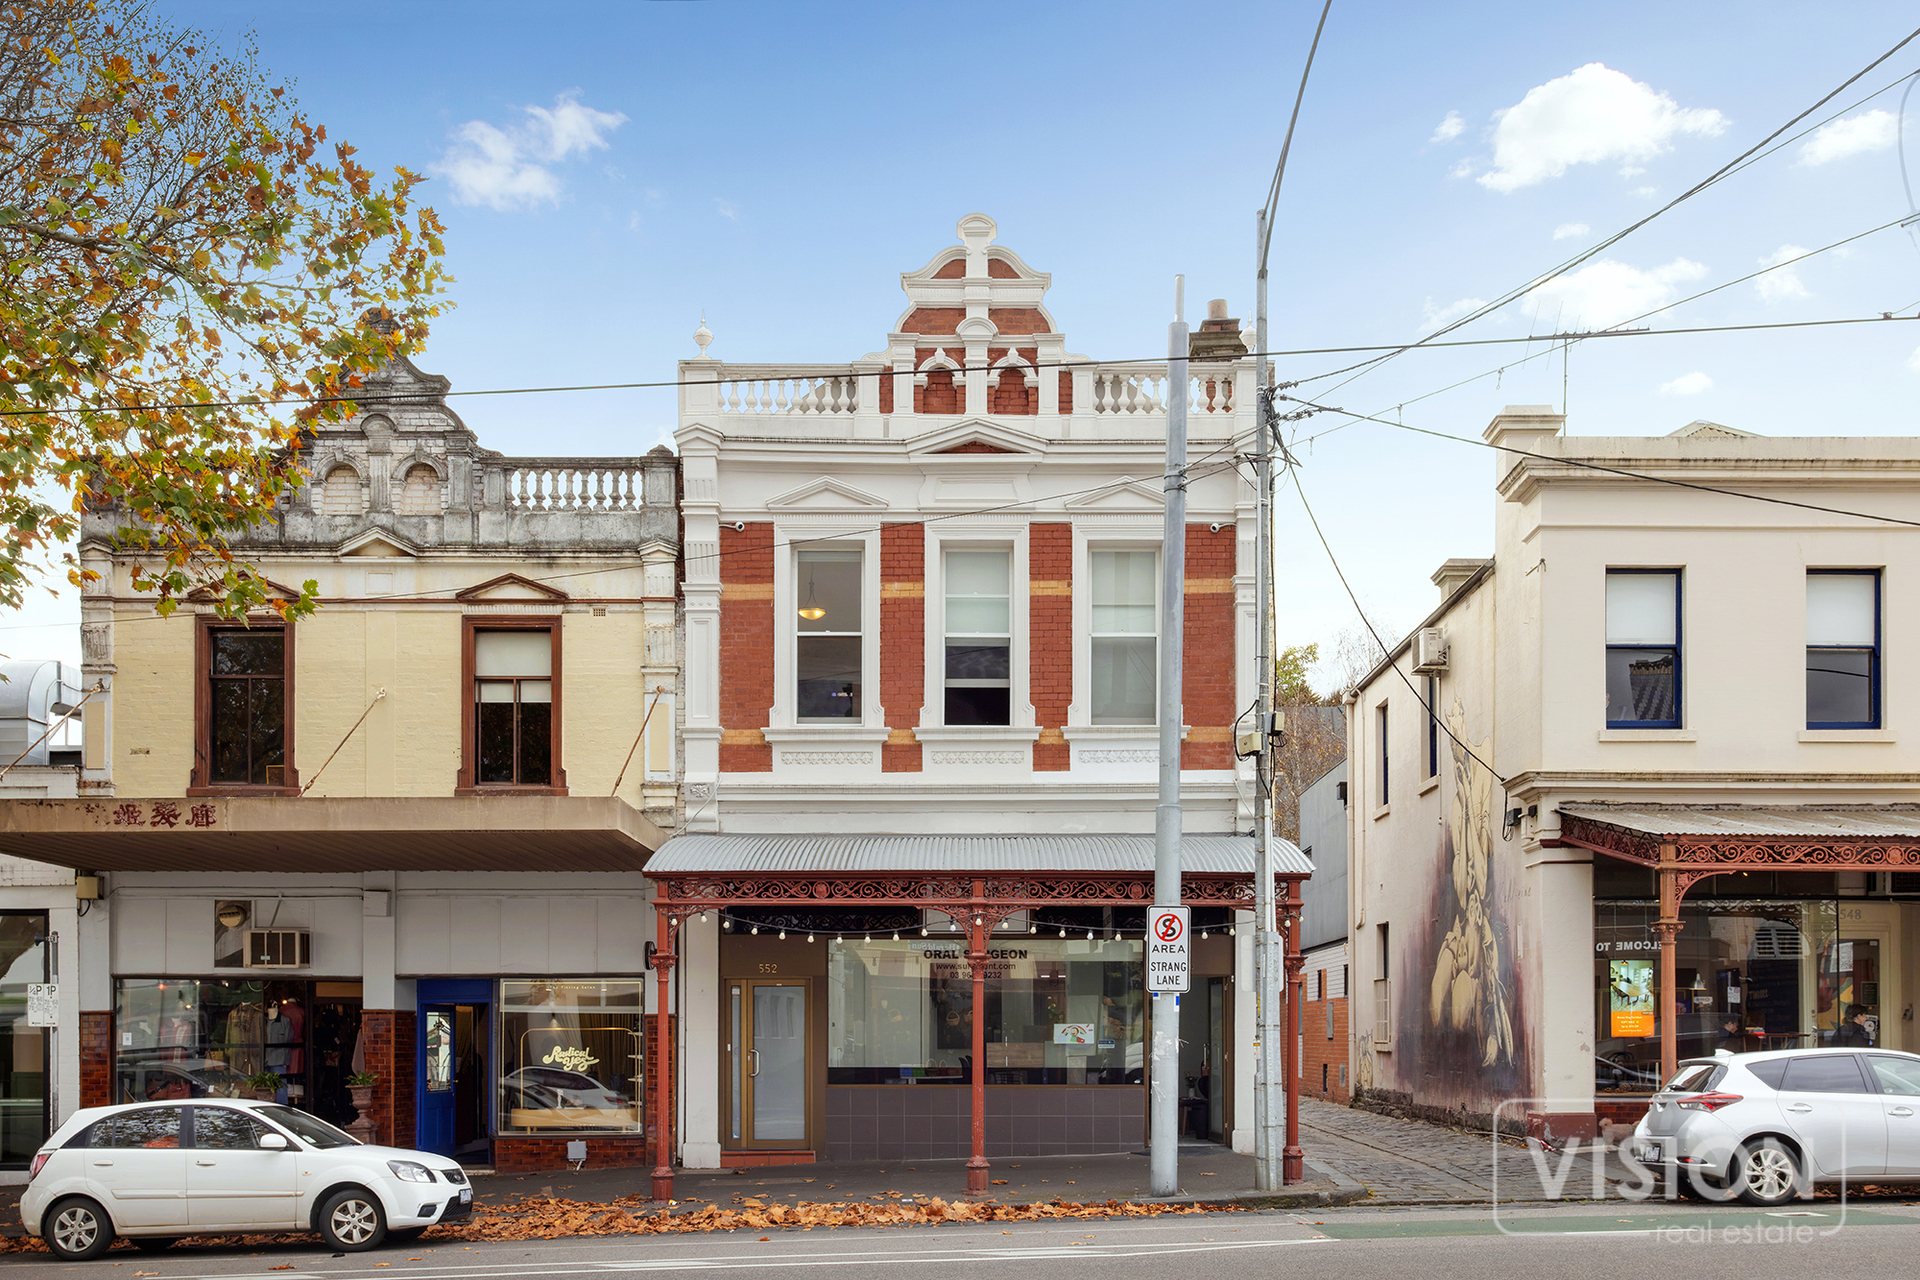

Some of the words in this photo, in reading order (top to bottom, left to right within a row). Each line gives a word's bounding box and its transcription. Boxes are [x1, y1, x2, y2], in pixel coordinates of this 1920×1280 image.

[1840, 909, 1862, 919] 548
[1152, 944, 1186, 953] AREA
[923, 949, 959, 959] ORAL
[963, 949, 1028, 959] GEON
[758, 963, 778, 974] 552
[1150, 961, 1187, 972] STRANG
[1156, 975, 1181, 985] LANE
[46, 985, 57, 996] 1P
[542, 1045, 595, 1064] Radical
